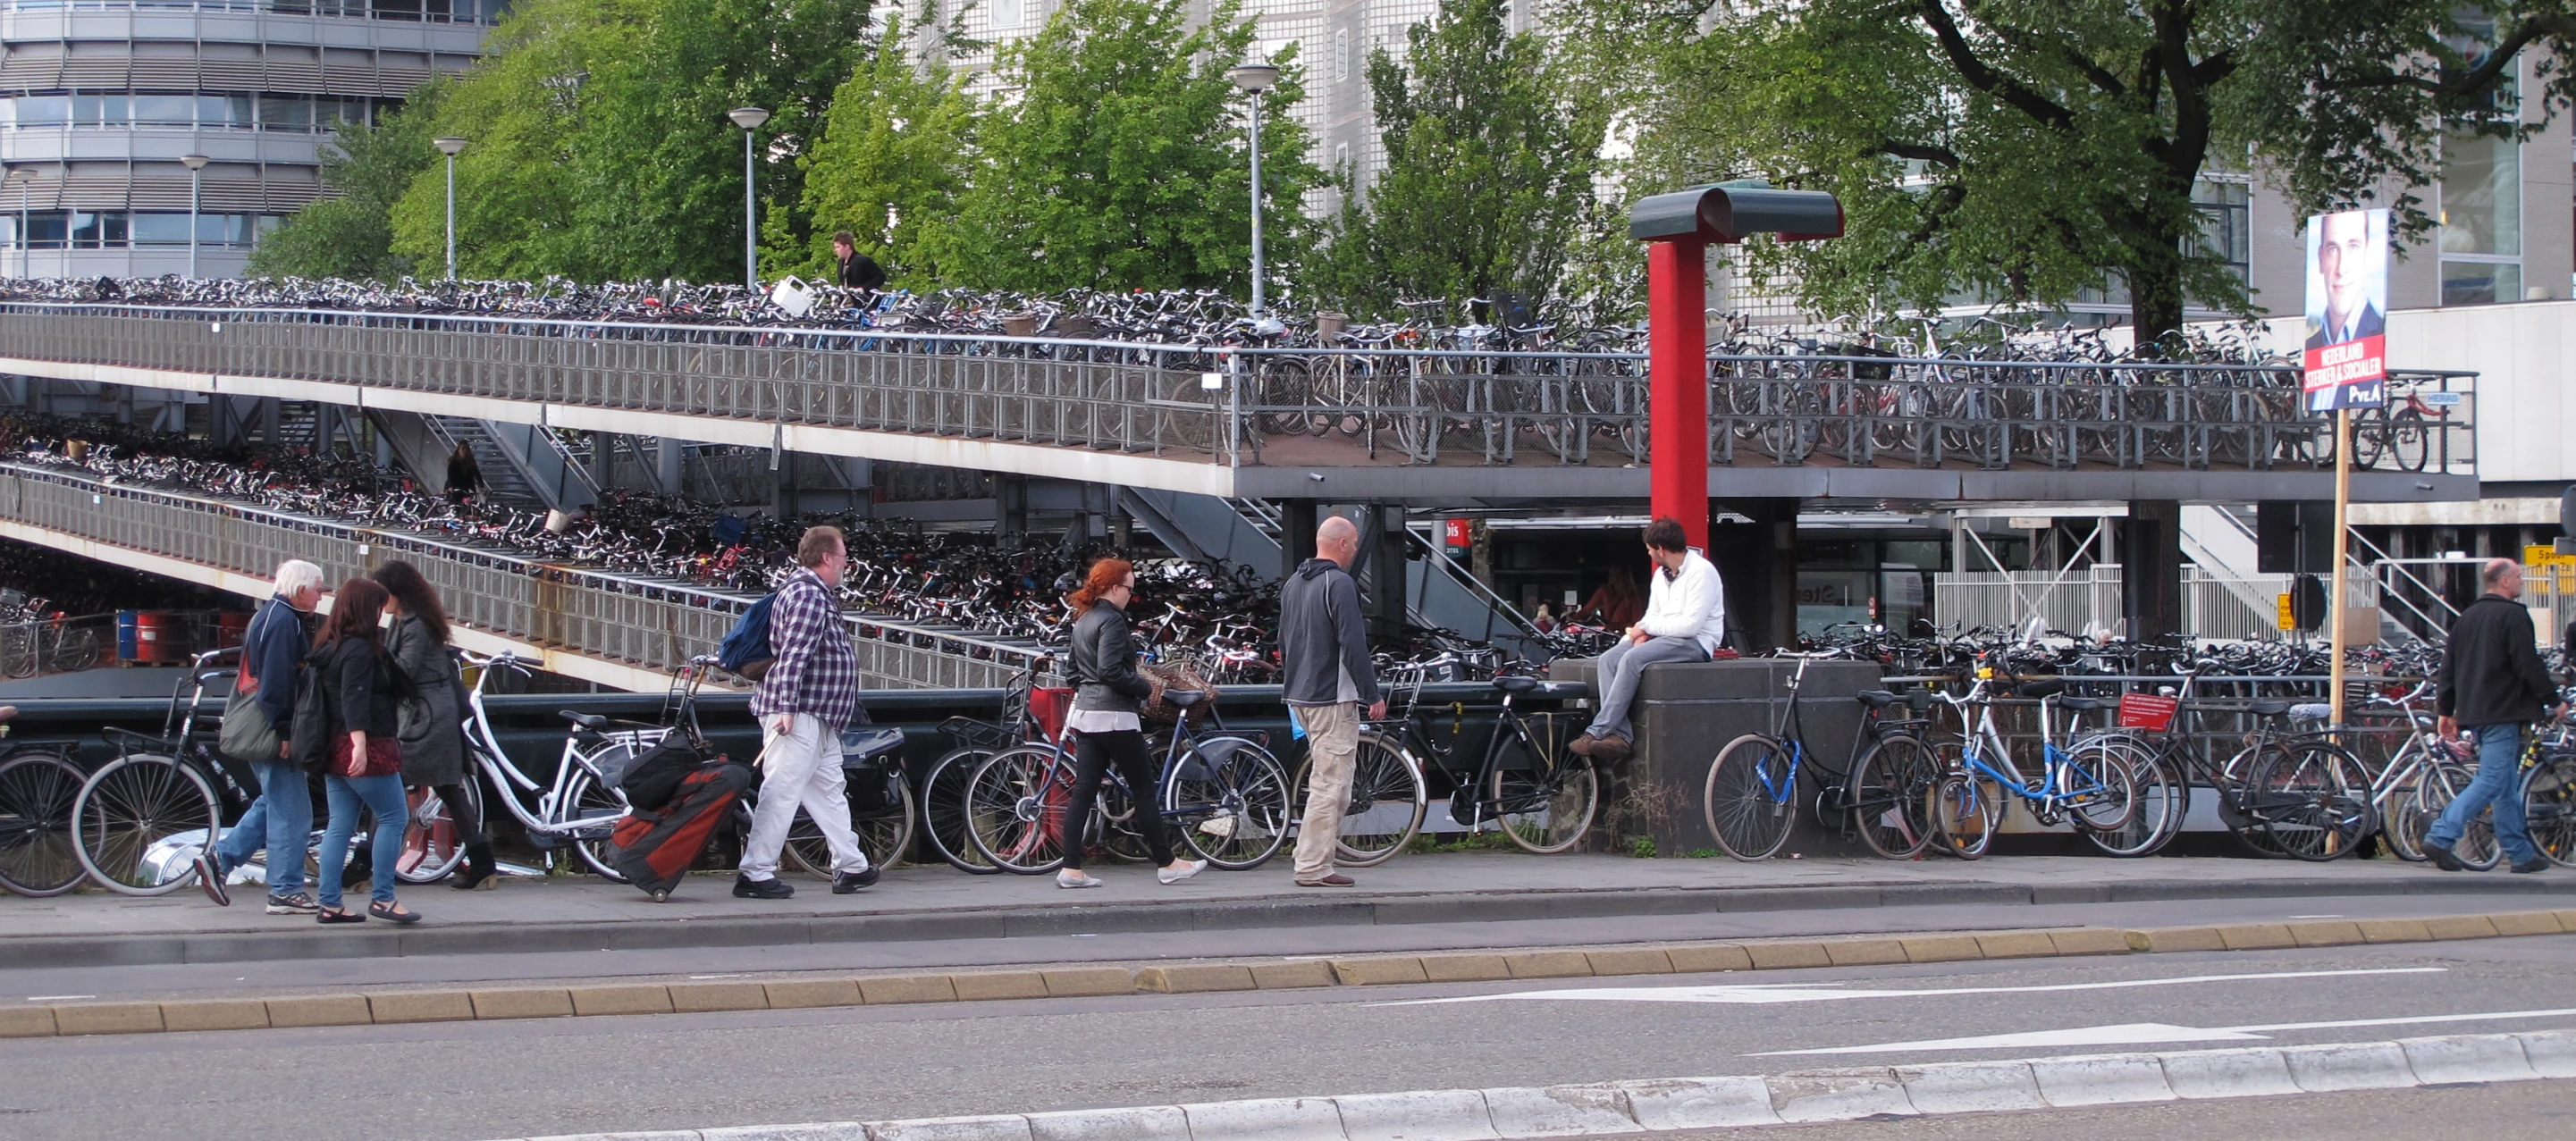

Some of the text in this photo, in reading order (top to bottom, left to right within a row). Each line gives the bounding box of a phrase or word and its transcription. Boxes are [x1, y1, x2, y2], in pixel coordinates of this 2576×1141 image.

[2320, 341, 2364, 367] NEDERLAND
[2304, 357, 2382, 390] STERKER & SOCIALER
